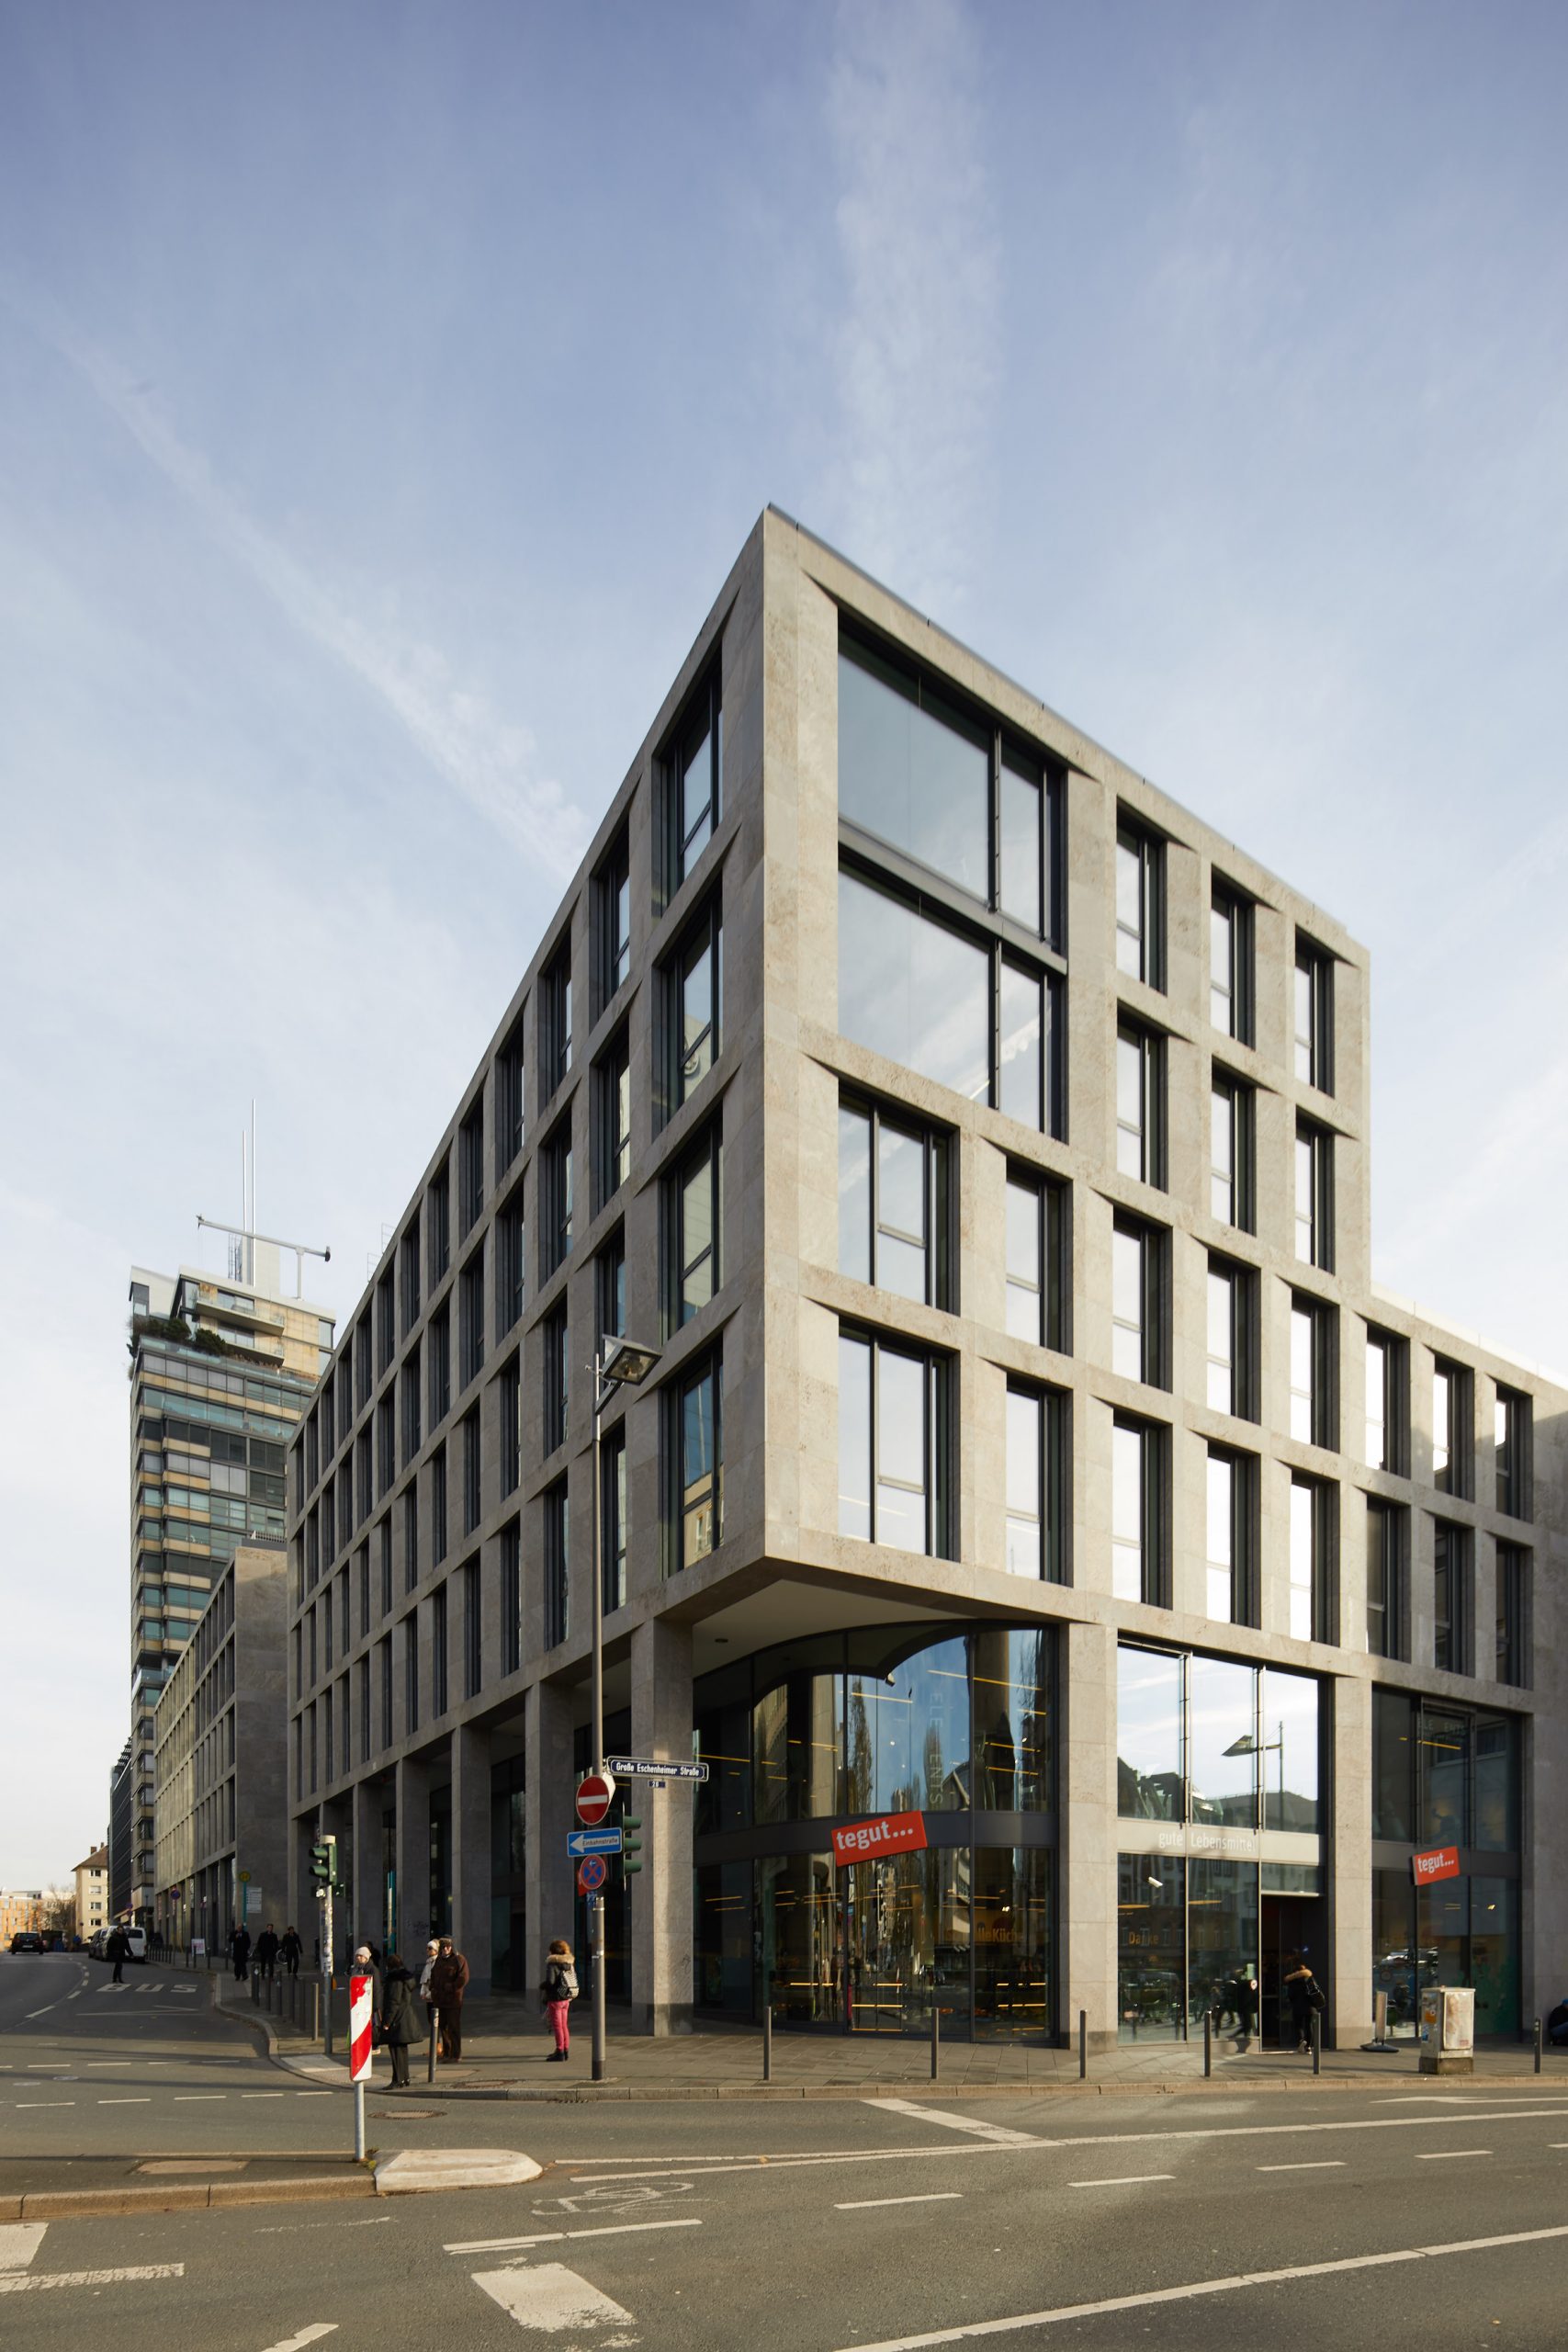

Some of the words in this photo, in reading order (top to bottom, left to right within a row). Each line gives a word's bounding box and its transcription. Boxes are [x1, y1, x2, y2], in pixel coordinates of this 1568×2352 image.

[616, 1762, 635, 1772] Große
[637, 1763, 677, 1775] Eschenheimer
[680, 1767, 700, 1776] Straße
[582, 1837, 618, 1847] Einbahnstraße
[837, 1821, 914, 1850] tegut...
[1158, 1830, 1183, 1849] gute
[1190, 1833, 1257, 1852] Lebensmittel
[1417, 1852, 1455, 1873] tegut...
[96, 1984, 197, 1993] BUS
